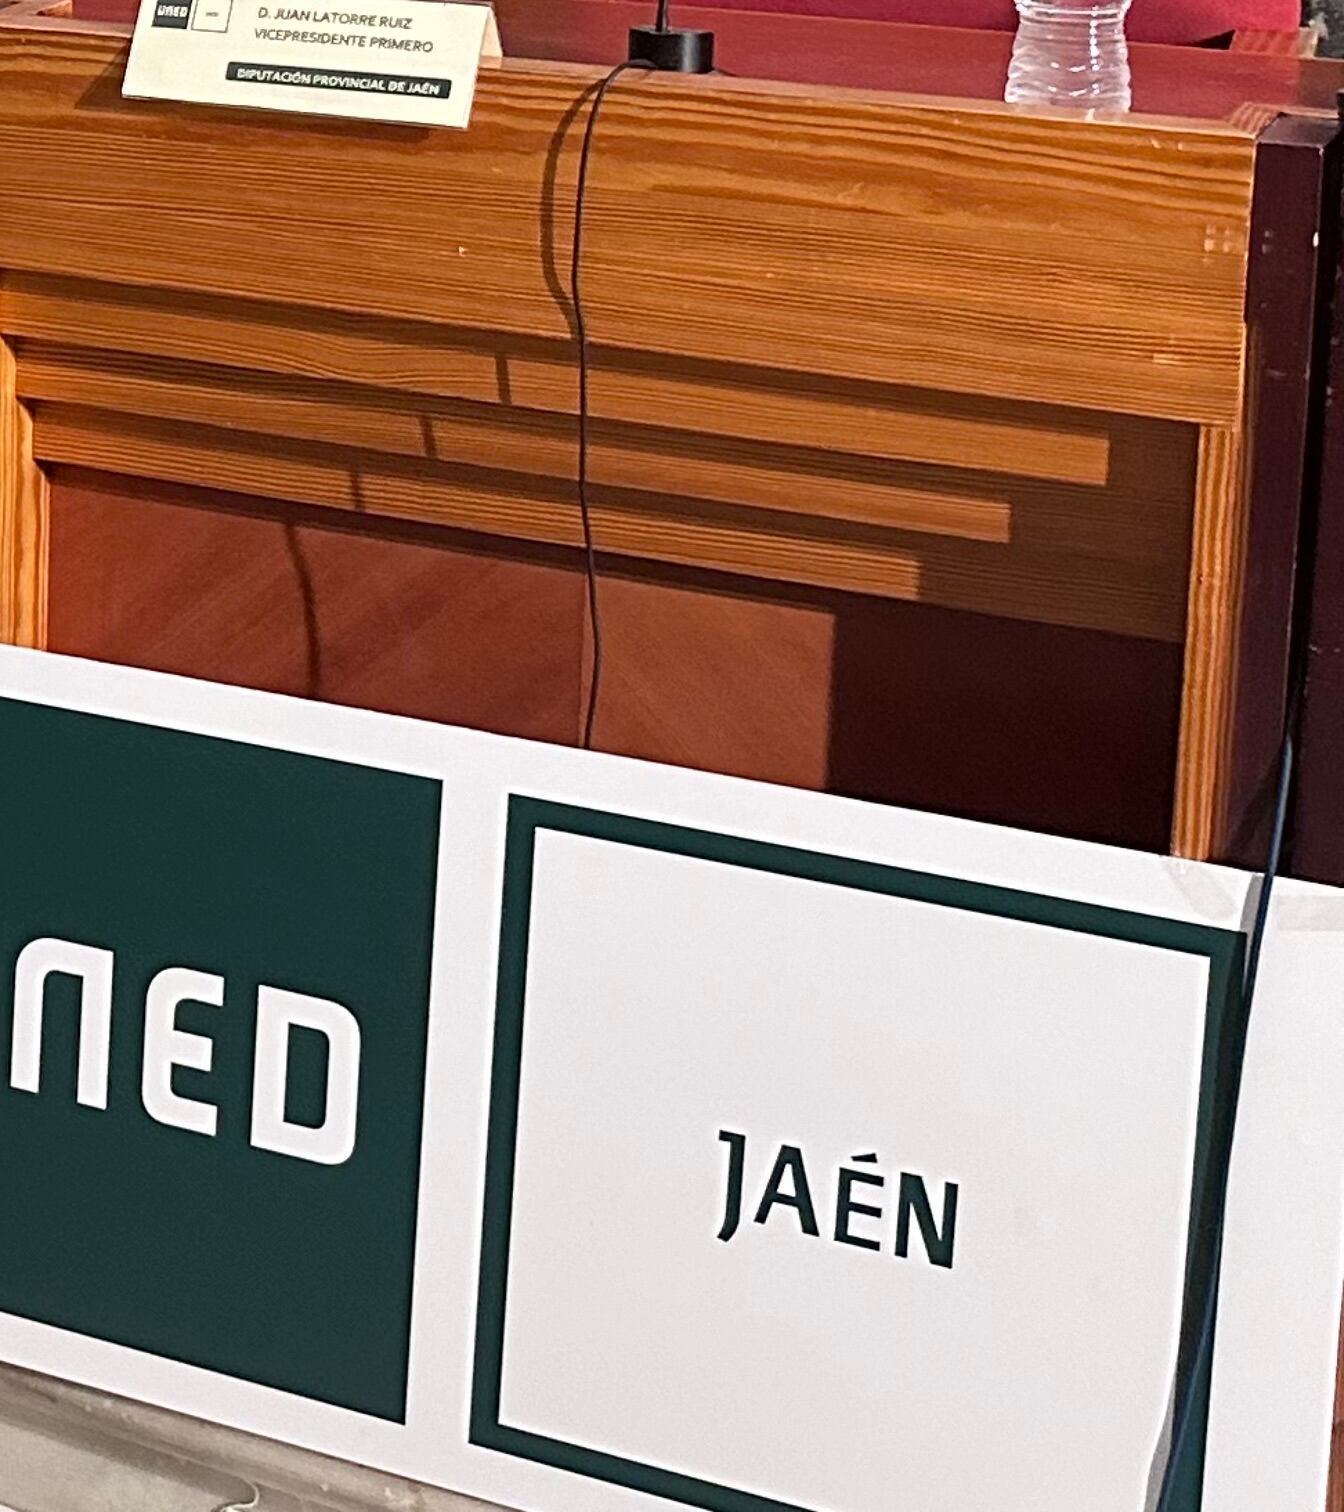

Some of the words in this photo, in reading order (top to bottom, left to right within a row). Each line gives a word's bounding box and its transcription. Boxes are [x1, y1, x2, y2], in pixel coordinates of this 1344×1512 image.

[157, 5, 188, 18] UNED
[258, 7, 271, 19] D.
[274, 9, 311, 22] JUAN
[313, 12, 376, 27] LATORRE
[379, 16, 413, 29] RUIZ
[255, 28, 366, 48] VICEPRESIDENTE
[369, 38, 434, 53] PRIMERO
[237, 68, 311, 85] DIPUTACIÓN
[313, 75, 386, 91] PROVINCIAL
[388, 81, 405, 92] DE
[406, 83, 440, 96] JAÉN
[717, 1129, 959, 1269] JAÉN
